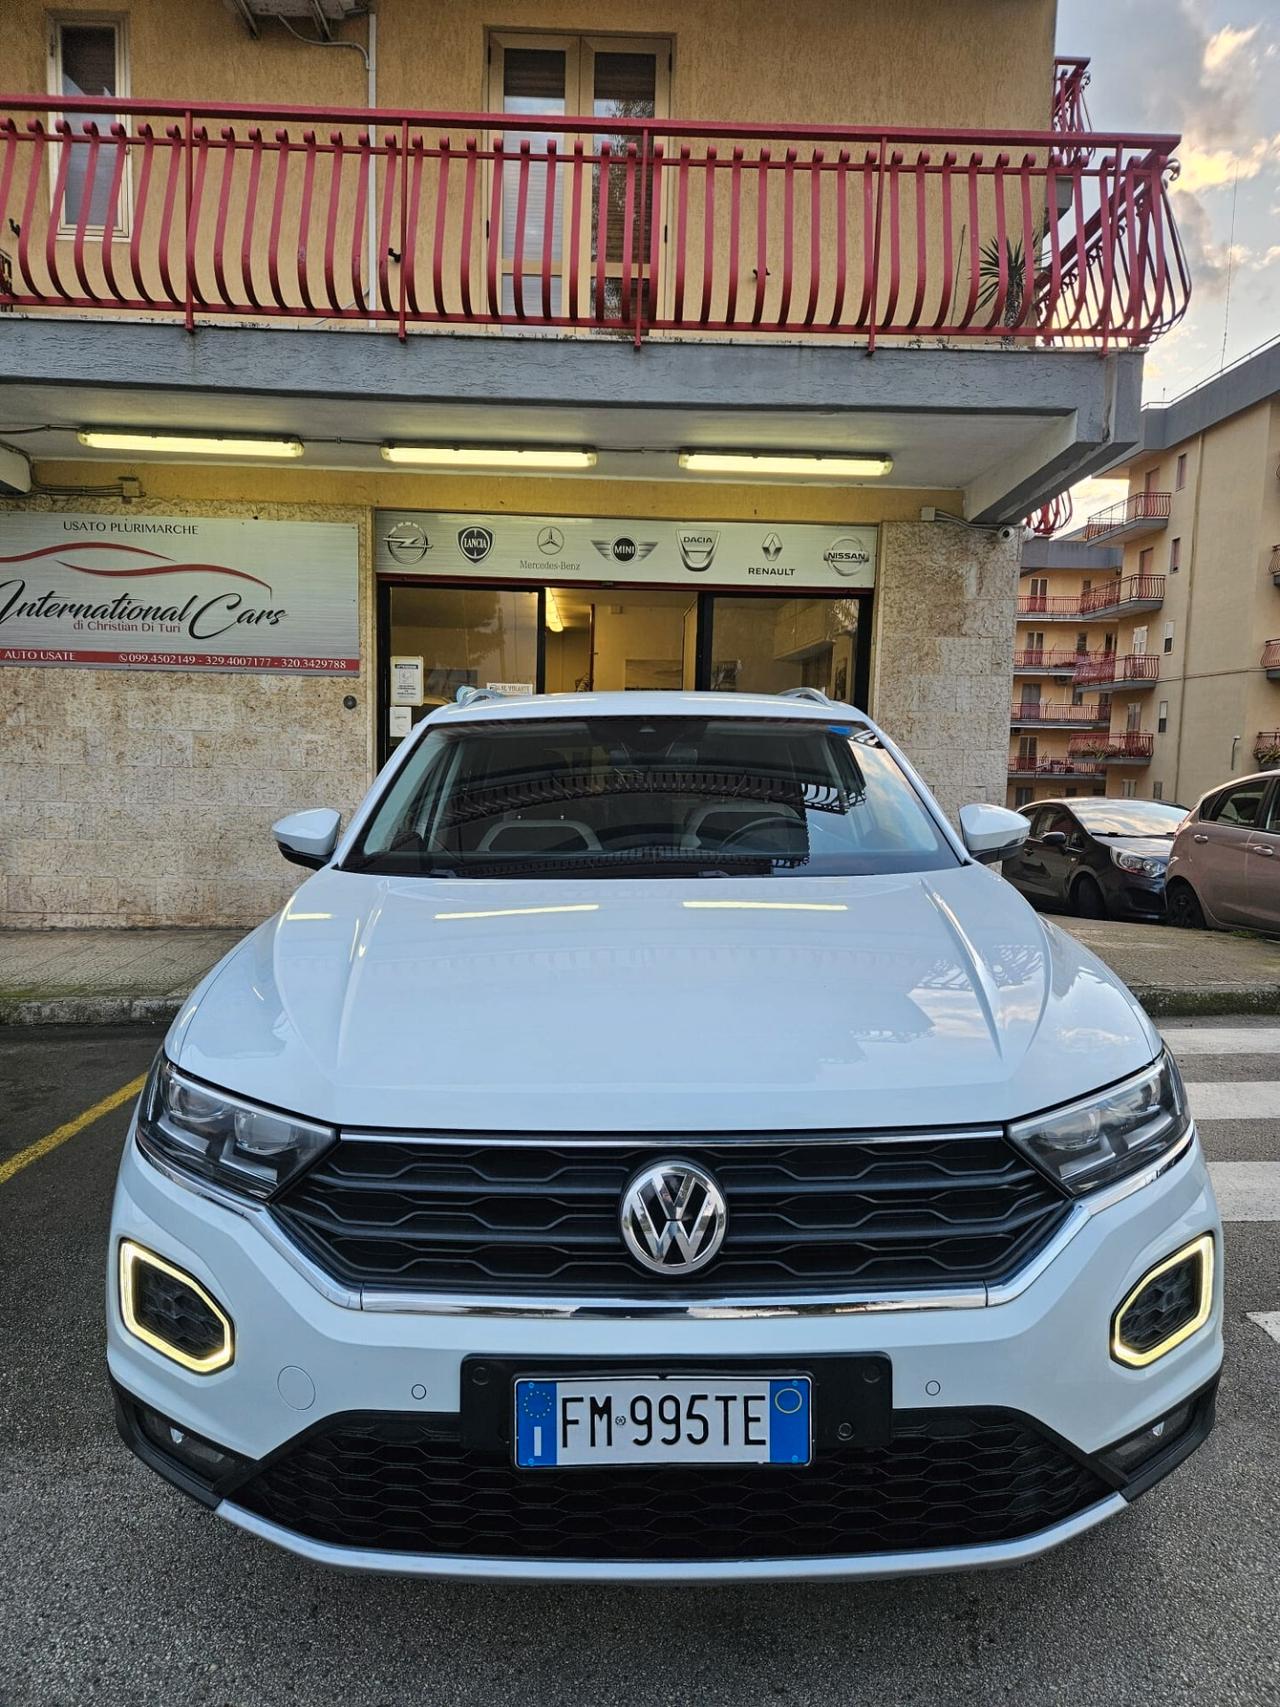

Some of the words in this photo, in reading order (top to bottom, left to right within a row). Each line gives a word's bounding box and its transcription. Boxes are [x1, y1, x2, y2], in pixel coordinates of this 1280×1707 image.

[63, 521, 106, 532] USATO
[110, 522, 199, 535] PLURIMARCHE
[464, 538, 487, 549] LANCIA
[683, 536, 713, 544] DACIA
[614, 545, 635, 554] MINI
[827, 552, 866, 561] NISSAN
[519, 560, 581, 571] Mercedes-Benz
[748, 567, 796, 576] RENAULT
[0, 579, 199, 625] International
[189, 592, 288, 639] Cars
[73, 620, 84, 631] di
[87, 621, 138, 633] Christian
[141, 622, 155, 633] Di
[158, 622, 181, 633] Turi
[4, 651, 38, 660] AUTO
[40, 651, 77, 661] USATE
[128, 653, 196, 664] 099.4502149
[205, 655, 271, 667] 329.4007177
[281, 658, 346, 669] 320.3429788
